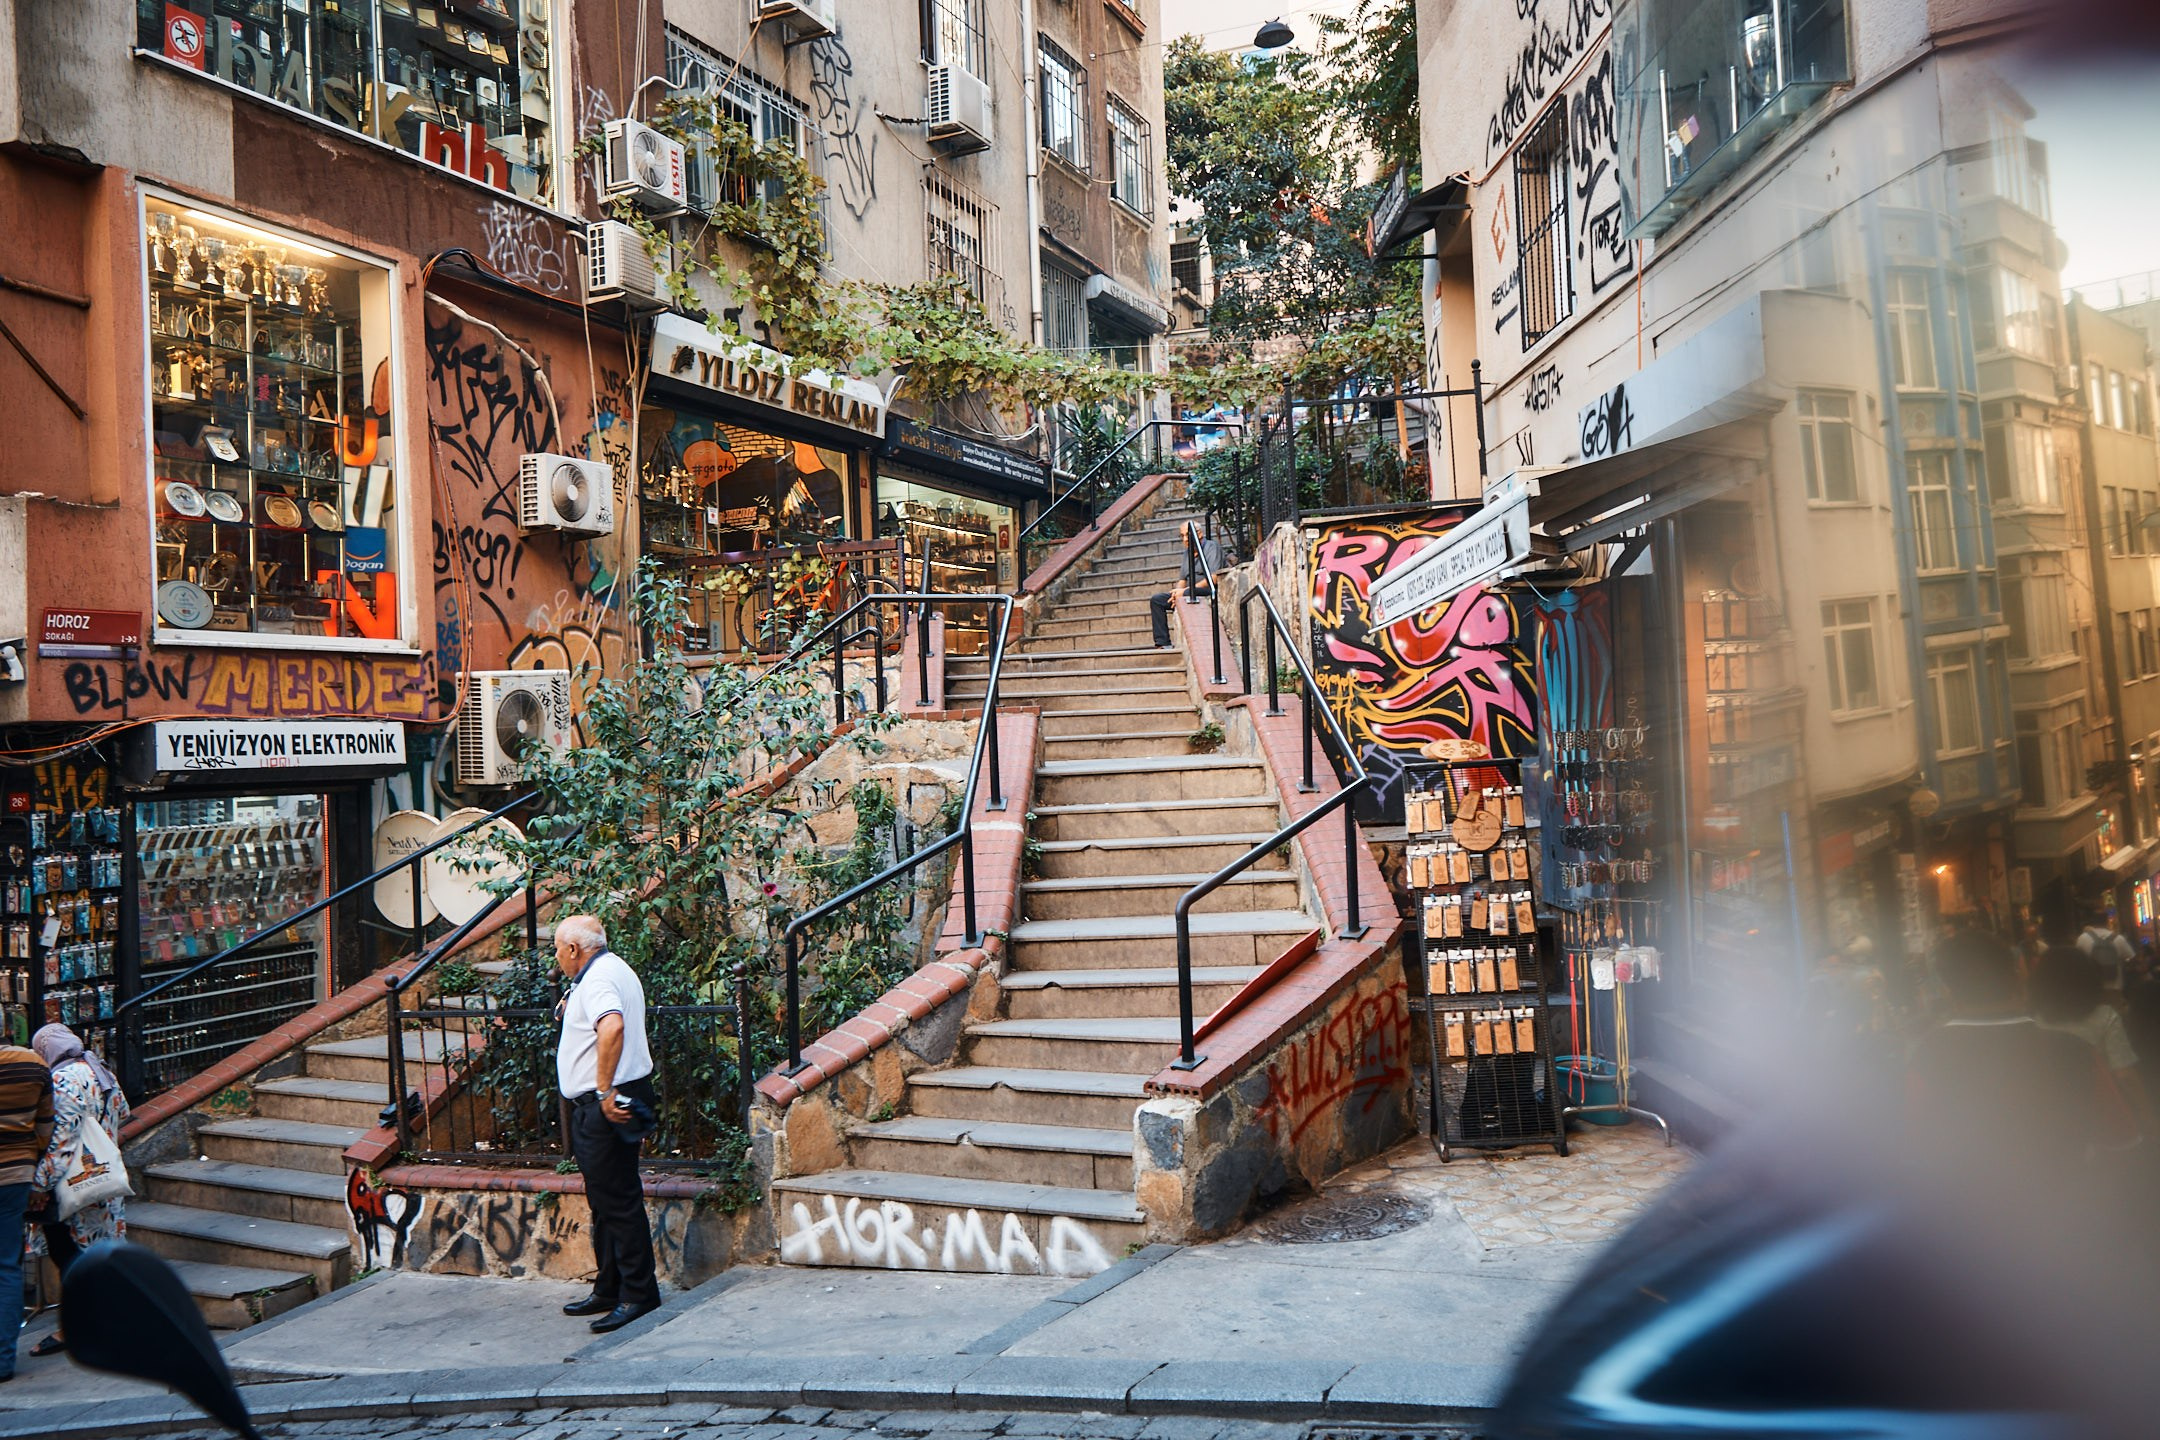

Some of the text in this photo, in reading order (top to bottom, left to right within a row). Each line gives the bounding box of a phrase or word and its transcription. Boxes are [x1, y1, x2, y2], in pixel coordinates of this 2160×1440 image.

[697, 350, 785, 405] YILDIZ
[790, 378, 879, 434] REKLAM
[45, 632, 75, 641] SOKAĞI
[46, 614, 91, 630] HOROZ
[63, 652, 196, 715] BLOW
[197, 653, 430, 716] MERDE
[168, 728, 397, 758] YENİVİZYON ELEKTRONİK
